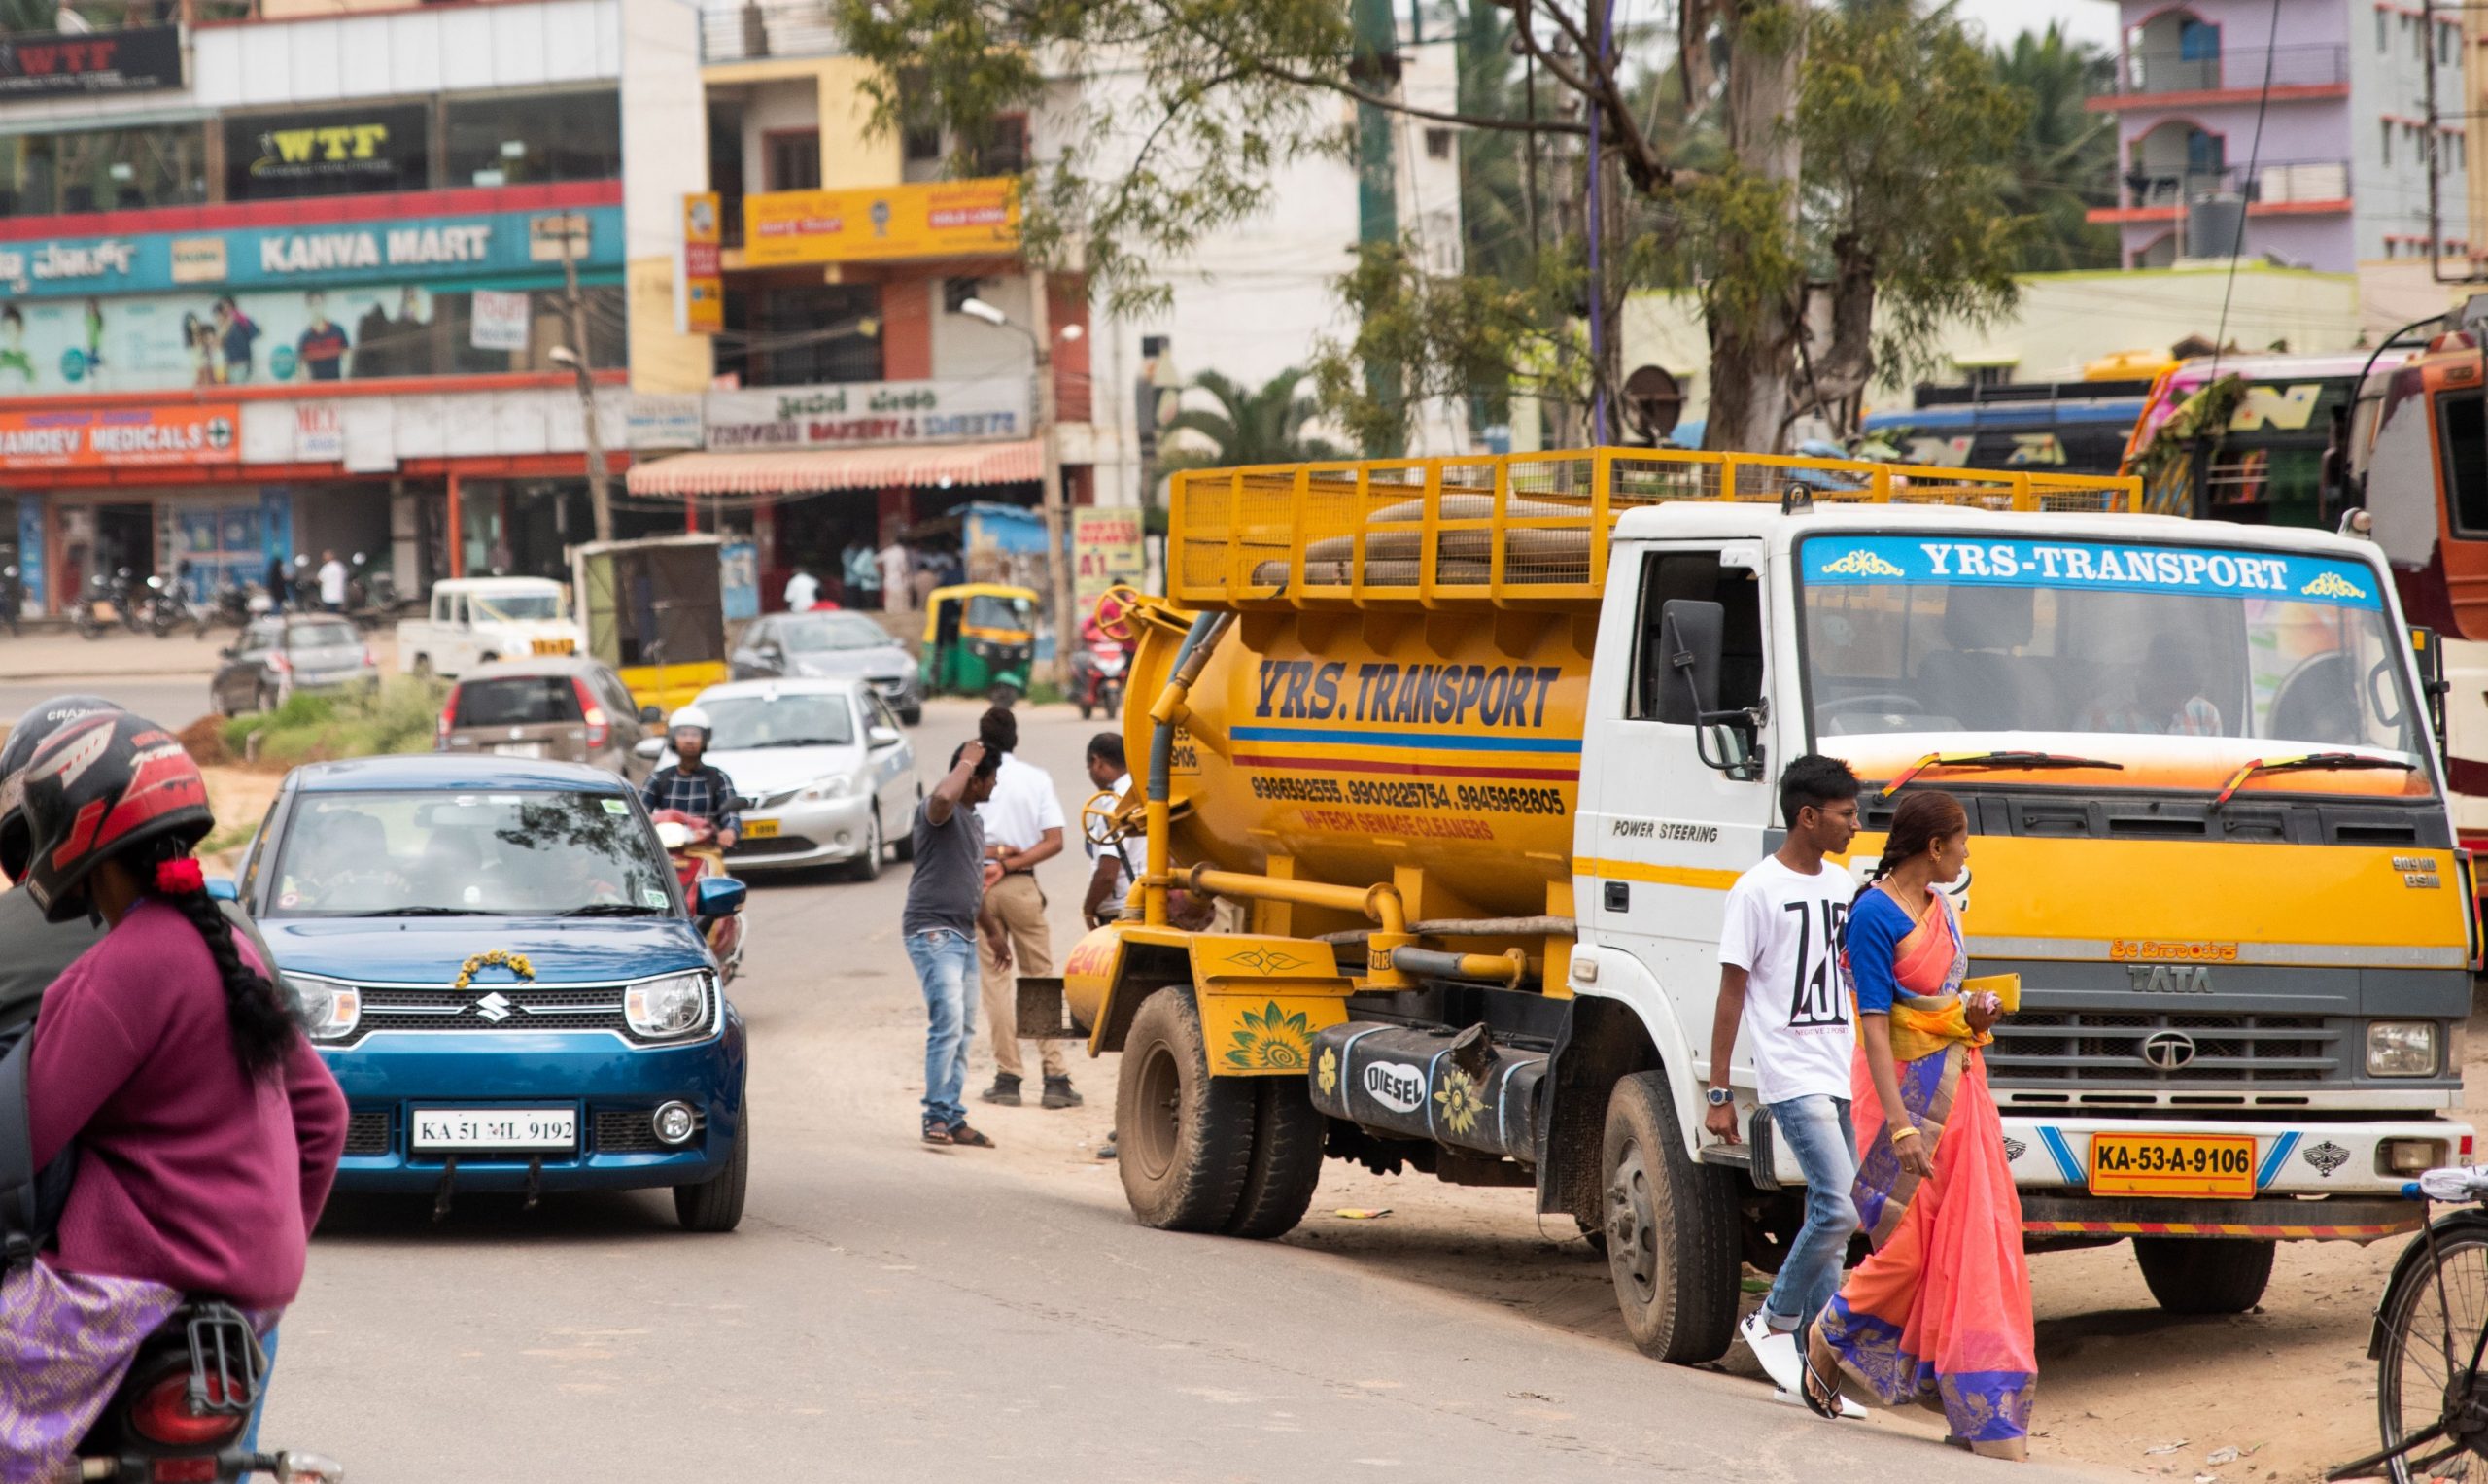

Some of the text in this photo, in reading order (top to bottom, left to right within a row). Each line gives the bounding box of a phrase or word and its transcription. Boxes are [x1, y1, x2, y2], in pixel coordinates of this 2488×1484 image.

[259, 226, 493, 273] KANVA MART
[0, 422, 203, 455] AMDEV MEDICALS
[809, 419, 899, 441] BAKERY
[1357, 812, 1414, 836] SEWAGE
[1415, 817, 1494, 841] CLEANERS
[1613, 820, 1717, 843] POWER STEERING
[2127, 965, 2214, 993] TATA
[1367, 1067, 1422, 1105] DIESEL
[422, 1122, 451, 1140] KA
[459, 1122, 478, 1139] 51
[529, 1122, 572, 1140] 9192
[2098, 1146, 2249, 1173] KA-53-A-9106
